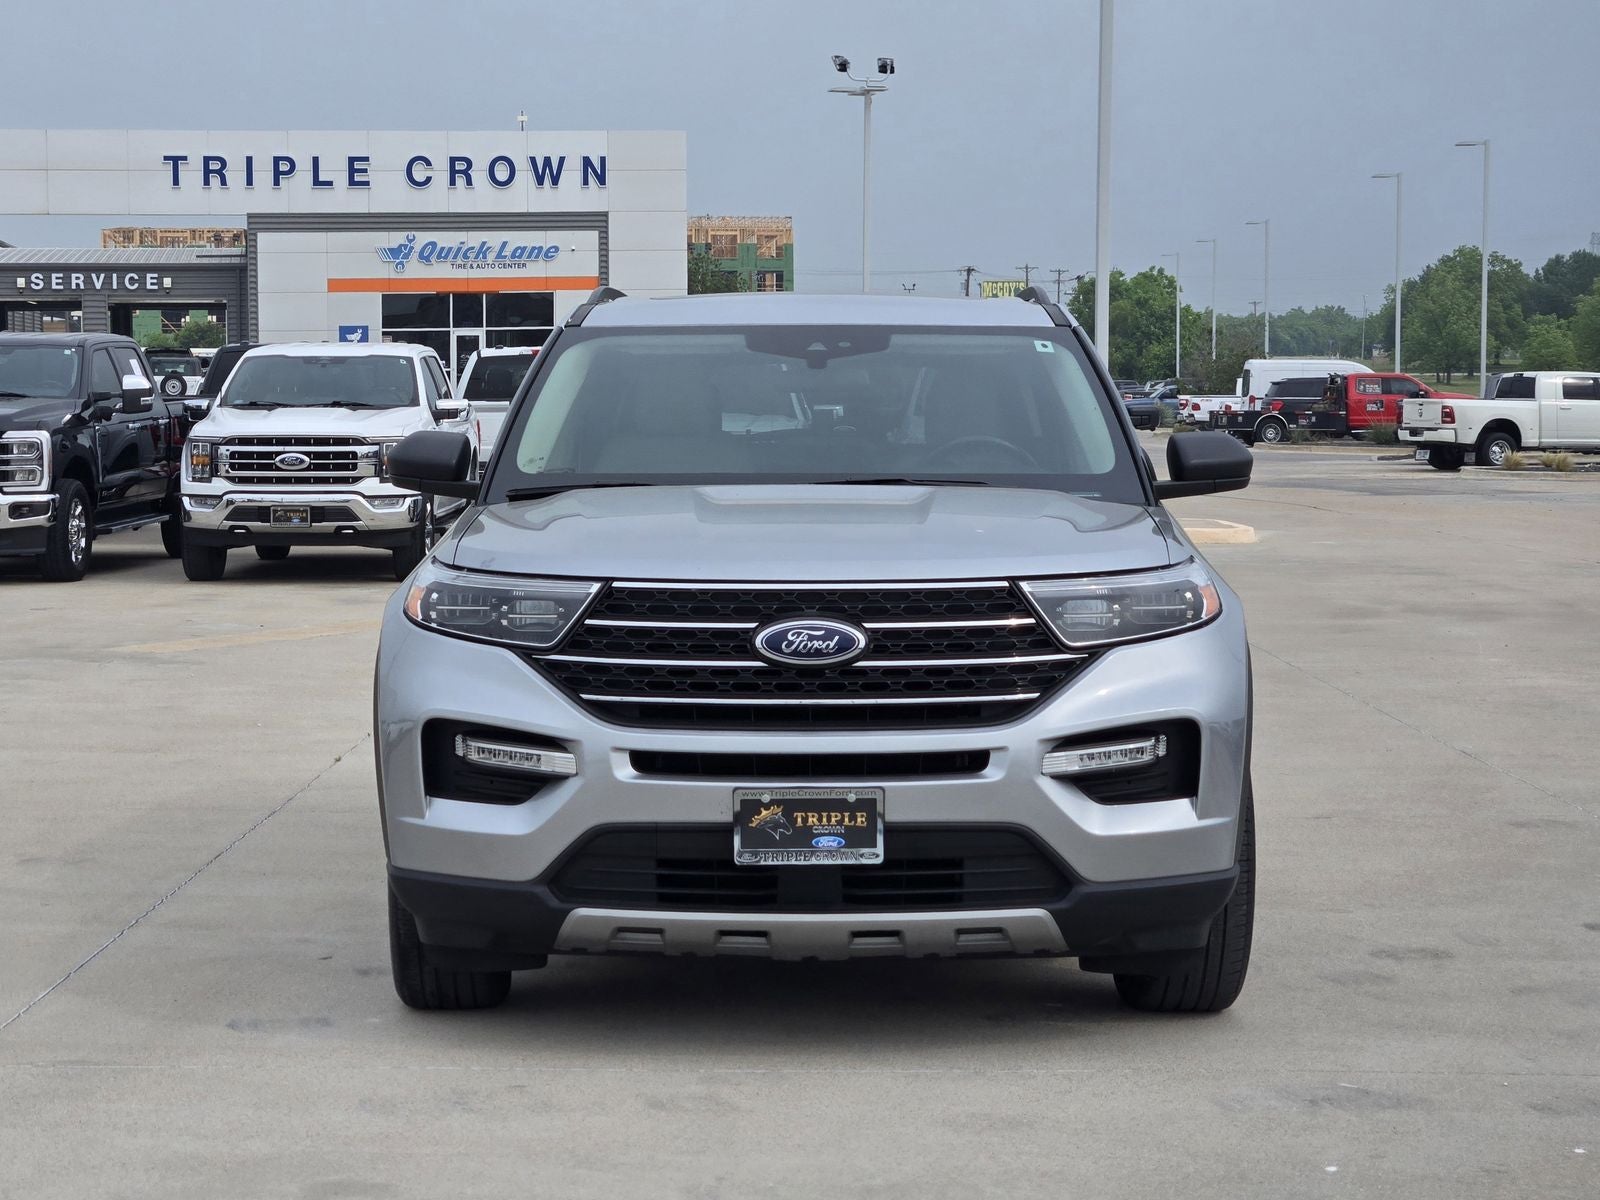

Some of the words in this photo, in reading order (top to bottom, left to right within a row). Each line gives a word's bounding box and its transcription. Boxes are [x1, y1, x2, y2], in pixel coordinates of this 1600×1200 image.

[162, 155, 372, 189] TRIPLE
[405, 155, 609, 189] CROWN
[417, 240, 496, 265] Quick
[494, 240, 561, 262] Lane
[30, 273, 159, 290] SERVICE
[781, 629, 839, 653] Ford
[741, 789, 877, 798] wwwTripleCrownFordcom
[793, 812, 867, 827] TRIPLE
[812, 825, 845, 834] CROWN
[760, 852, 811, 862] TRIPLE
[814, 852, 858, 861] CROWN
